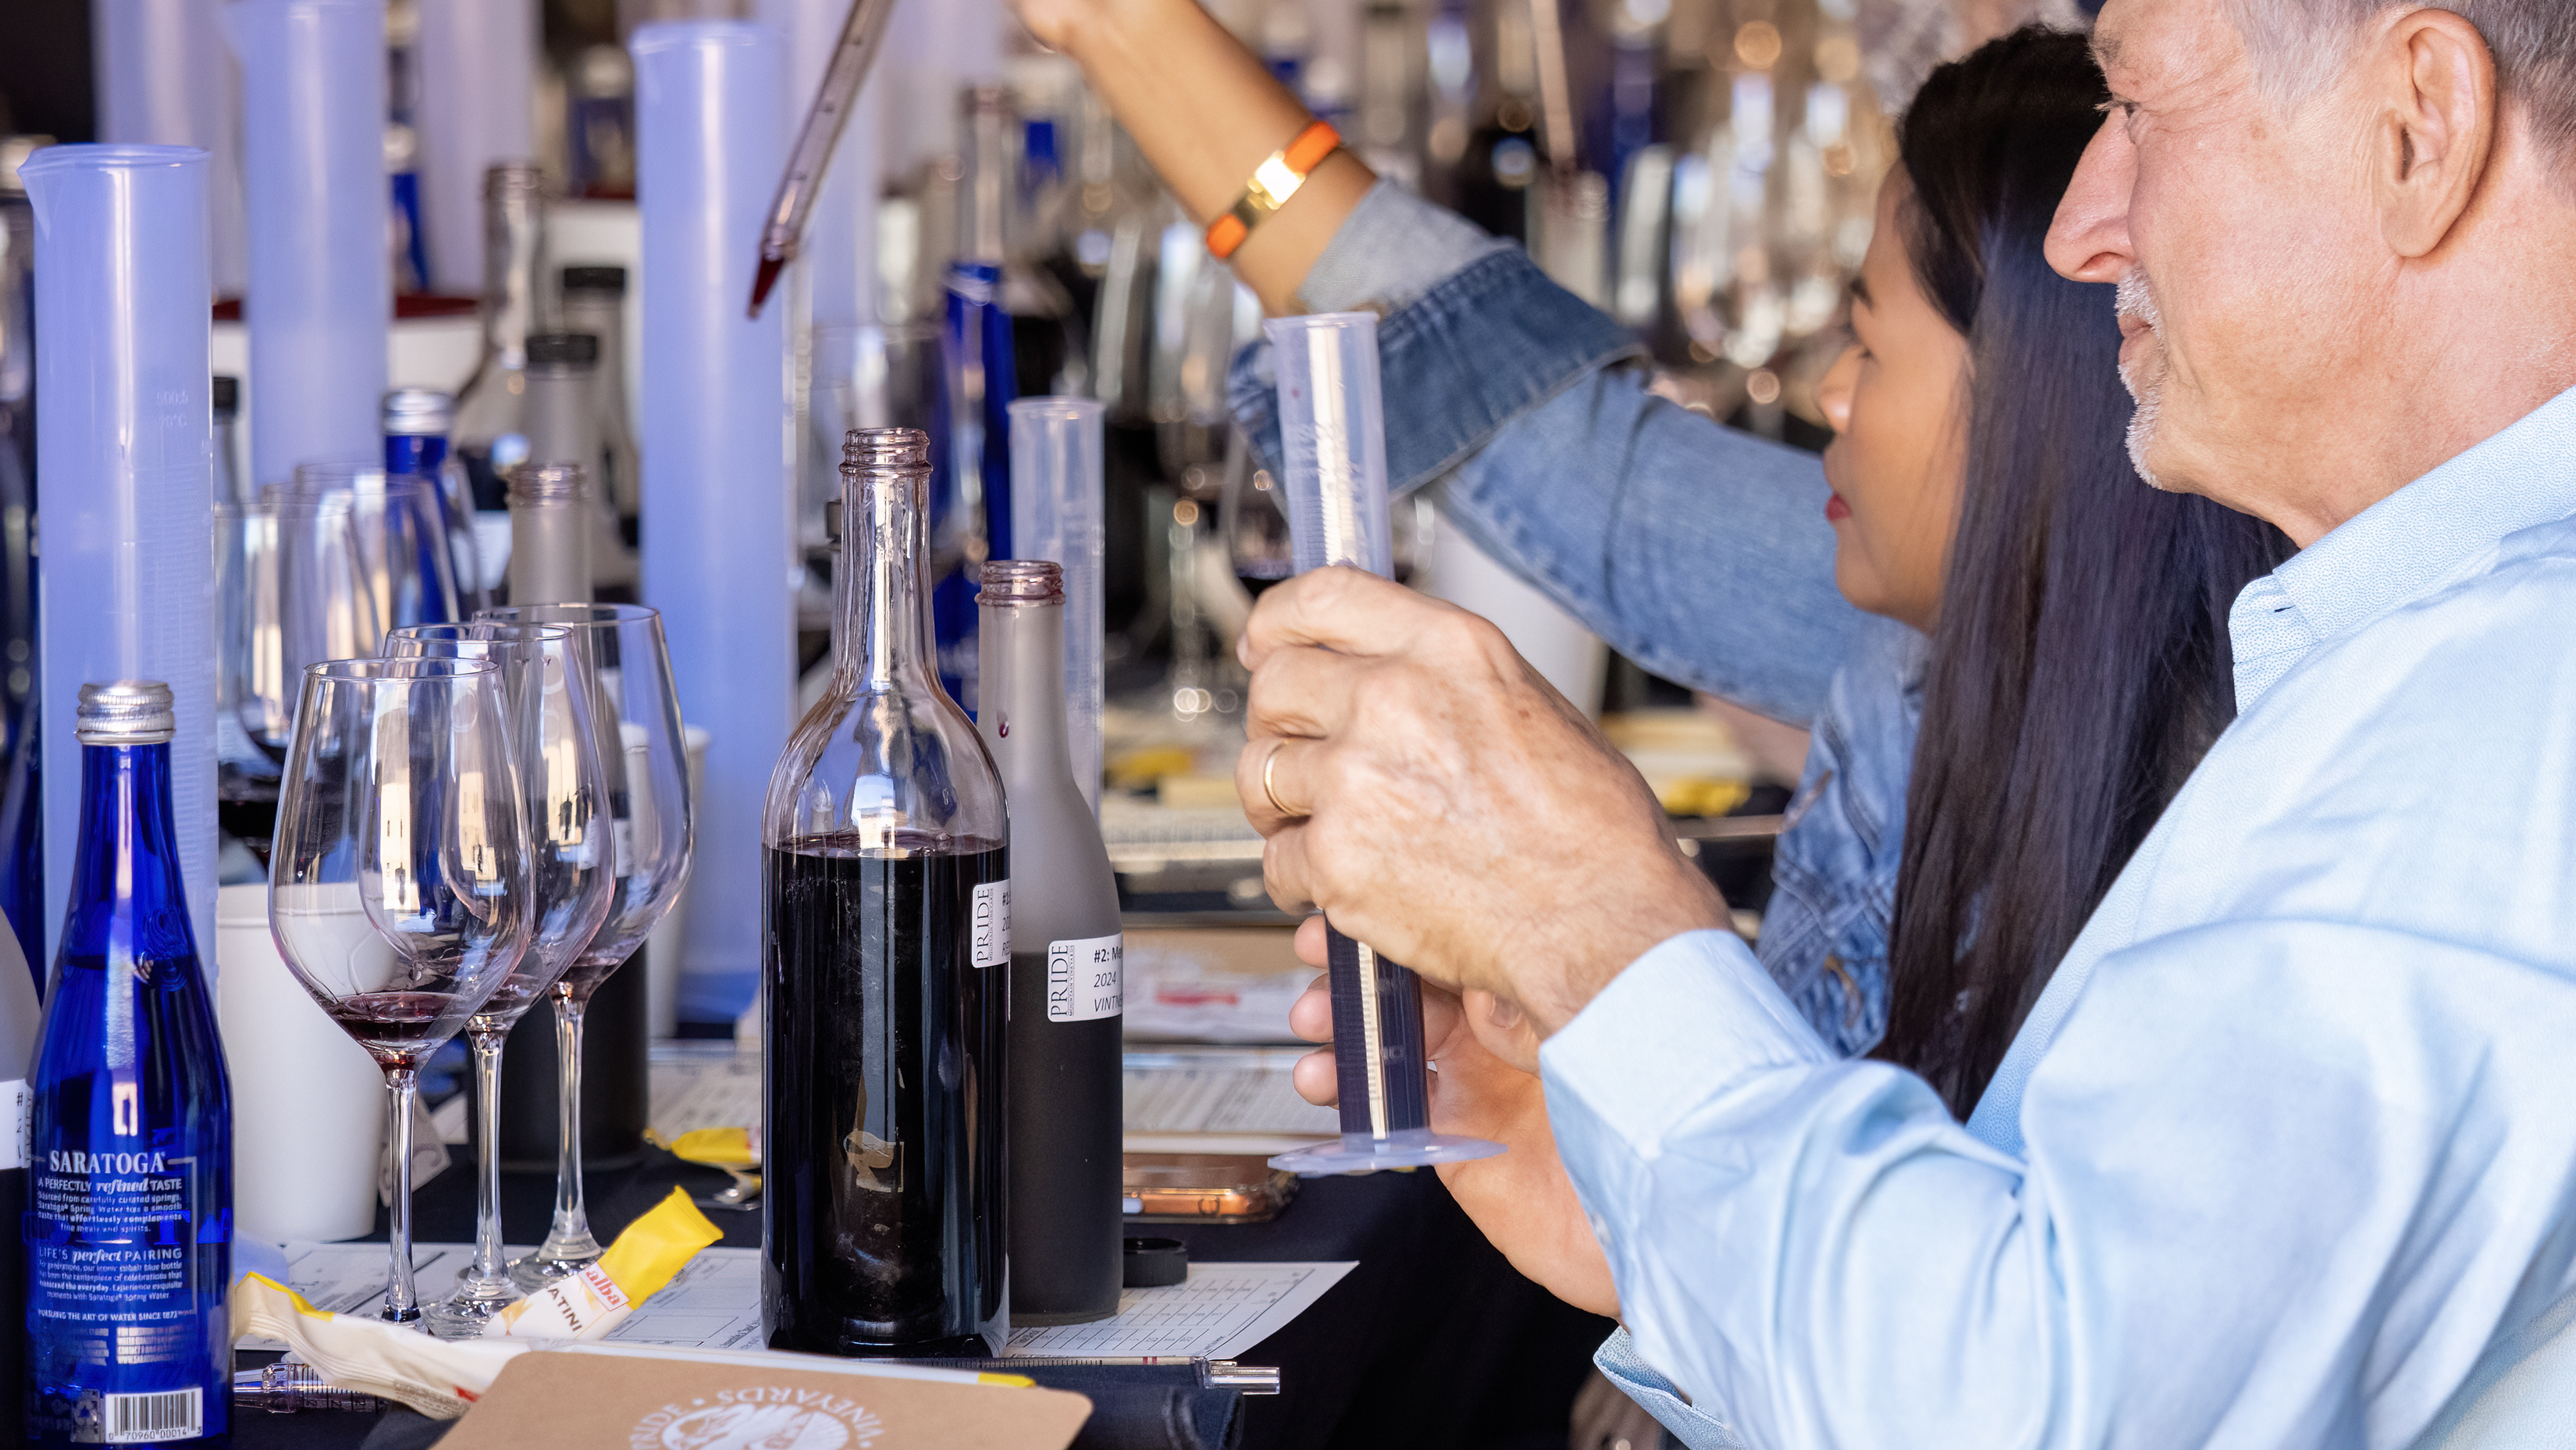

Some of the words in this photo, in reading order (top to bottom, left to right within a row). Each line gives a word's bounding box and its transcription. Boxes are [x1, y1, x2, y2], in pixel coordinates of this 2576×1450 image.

[977, 889, 989, 962] PRIDE
[1094, 949, 1109, 964] #2:
[1051, 944, 1069, 1017] PRIDE
[1094, 971, 1116, 988] 2024
[49, 1149, 165, 1174] SARATOGA
[37, 1177, 44, 1187] A
[45, 1177, 92, 1192] PERFECTLY
[96, 1177, 148, 1195] refined
[149, 1178, 183, 1192] TASTE
[62, 1193, 80, 1202] from
[39, 1246, 68, 1260] LIFE'S
[73, 1249, 122, 1264] perfect
[125, 1248, 182, 1261] PAIRING
[585, 1270, 621, 1306] alba
[68, 1312, 80, 1320] THE
[82, 1313, 96, 1321] ART
[110, 1313, 137, 1321] WATER
[138, 1312, 162, 1321] SINCE
[126, 1430, 155, 1441] 70960
